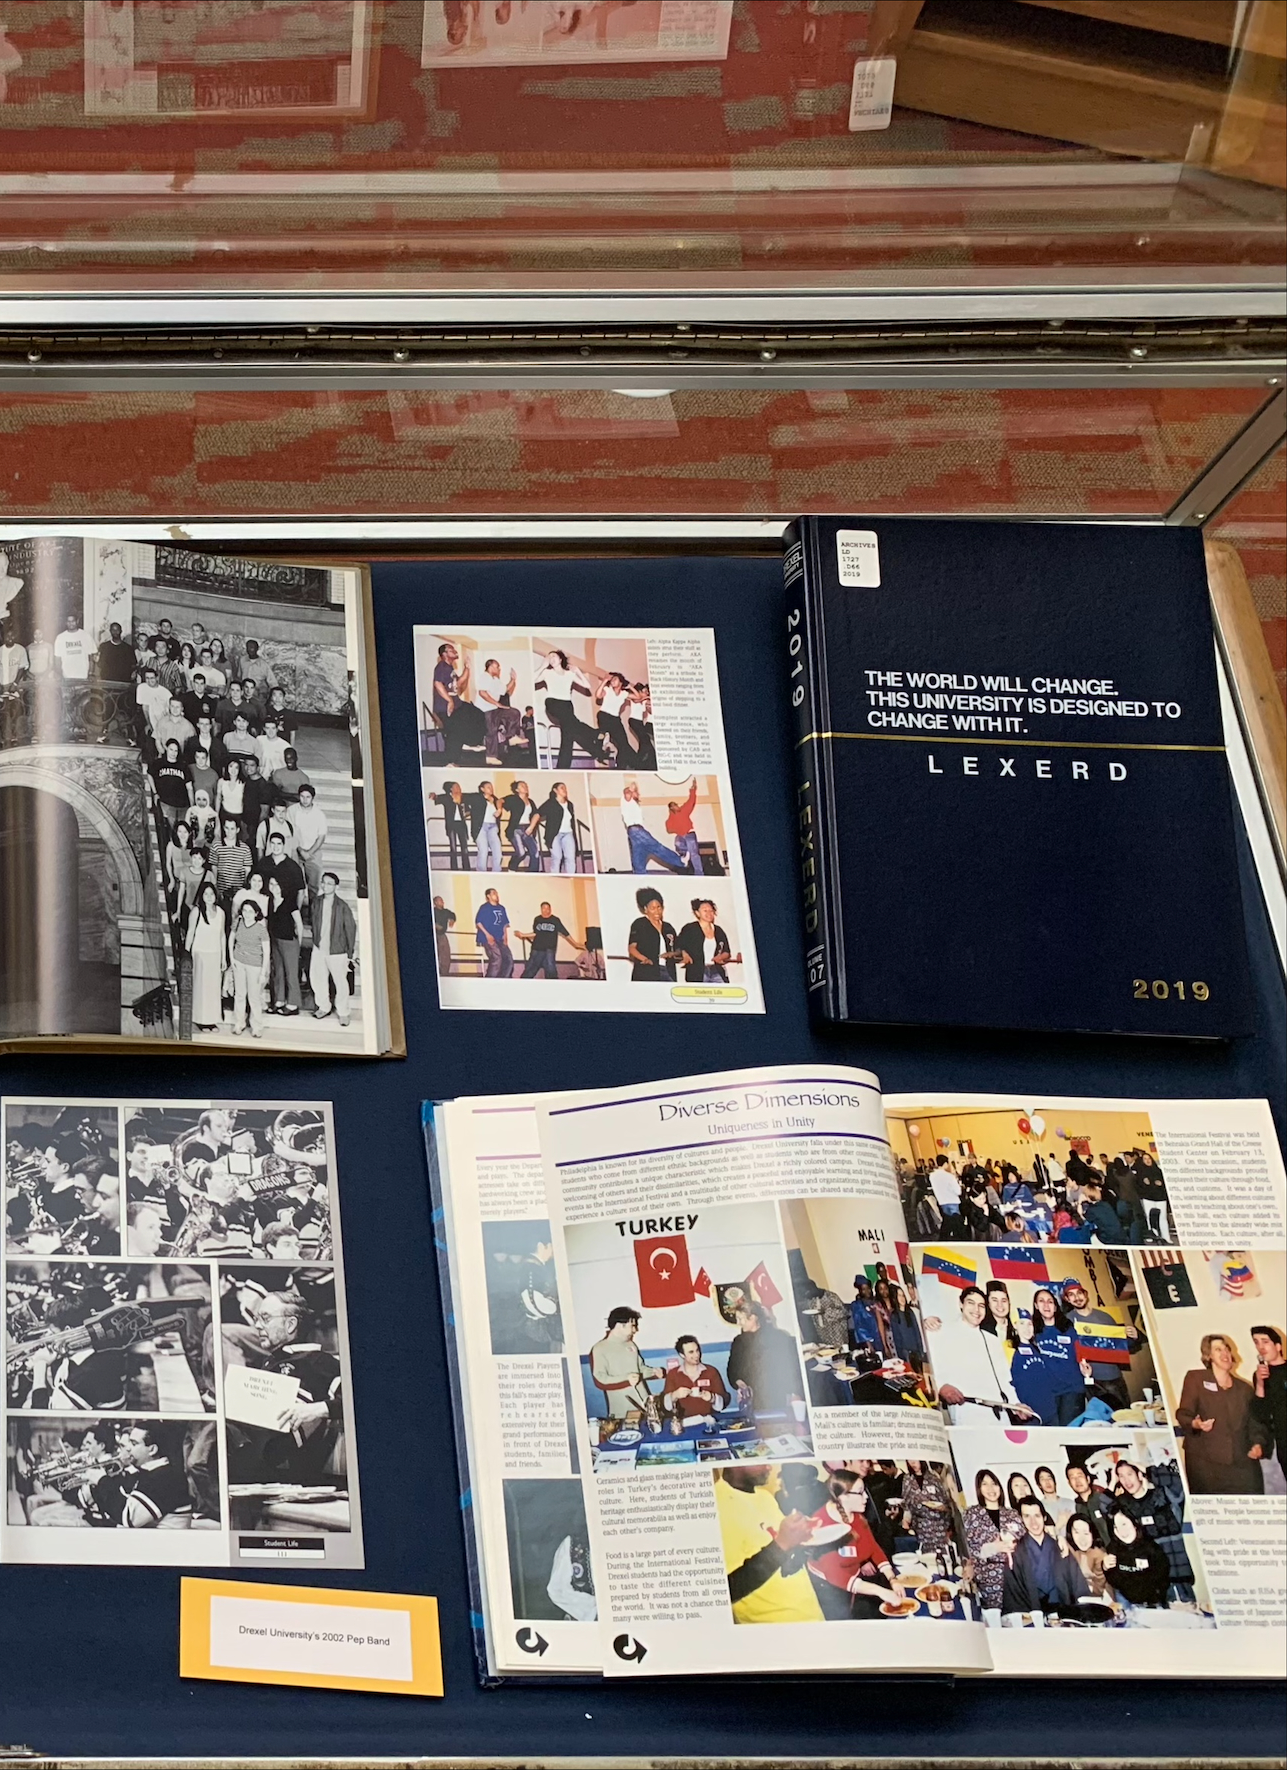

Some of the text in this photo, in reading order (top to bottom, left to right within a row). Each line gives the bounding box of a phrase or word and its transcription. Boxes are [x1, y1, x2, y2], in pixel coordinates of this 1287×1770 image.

[788, 608, 805, 707] 2019
[864, 670, 1119, 696] THE WORLD WILL CHANGE.
[866, 691, 1181, 719] THIS UNIVERSITY IS DESIGNED TO
[867, 711, 948, 730] CHANGE
[927, 755, 1127, 782] LEXERD
[798, 781, 818, 934] LEXERD
[1132, 979, 1210, 1002] 2019
[659, 1088, 860, 1122] Diverse Dimensions
[707, 1116, 815, 1136] Uniqueness in Unity
[250, 1173, 291, 1191] DRAGONS
[615, 1214, 699, 1237] TURKEY
[858, 1228, 887, 1243] MALI
[239, 1625, 390, 1646] Drexel University's 2002 Pep Band
